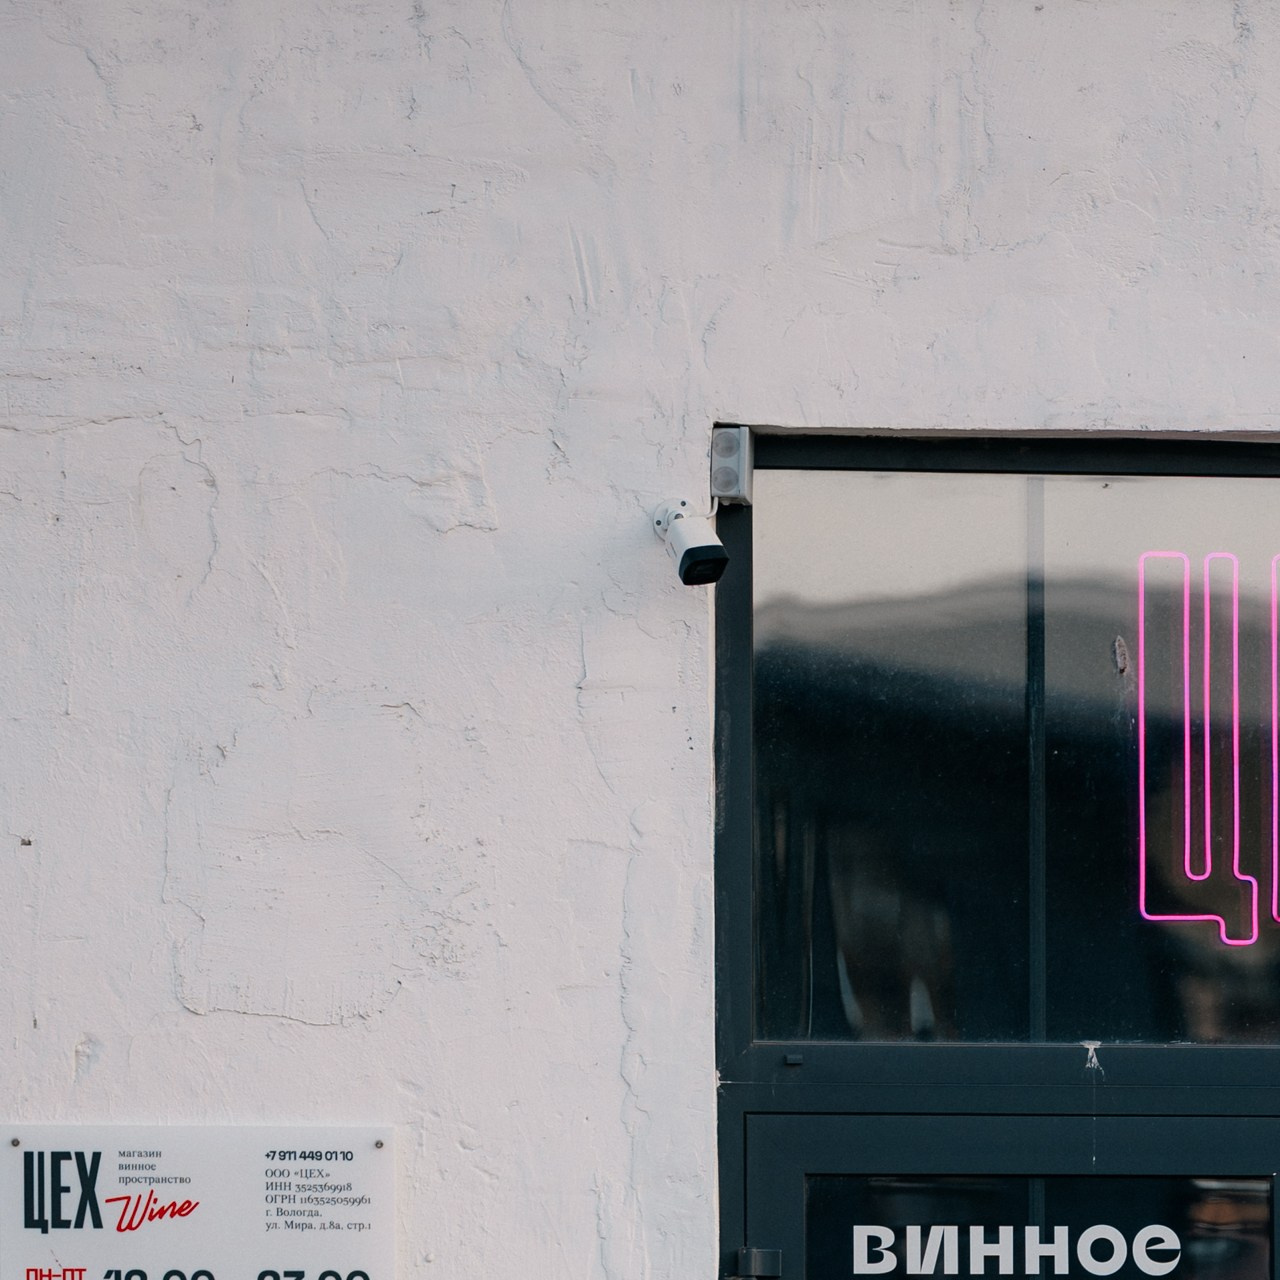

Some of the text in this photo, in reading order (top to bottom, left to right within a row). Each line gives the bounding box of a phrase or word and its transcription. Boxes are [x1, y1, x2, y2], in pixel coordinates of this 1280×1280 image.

[118, 1150, 162, 1158] магазин
[265, 1151, 354, 1161] +7 911 449 01 10
[118, 1163, 157, 1171] винное
[265, 1168, 330, 1179] ООО «ЦЕХ»
[118, 1176, 191, 1186] пространство
[24, 1151, 103, 1234] ЦЕХ
[265, 1182, 353, 1194] ИНН 3525369918
[265, 1194, 371, 1207] ОГРН 1163525059961
[105, 1189, 200, 1233] Wine
[266, 1209, 273, 1217] г.
[265, 1222, 281, 1232] ул.
[853, 1224, 1182, 1276] винное
